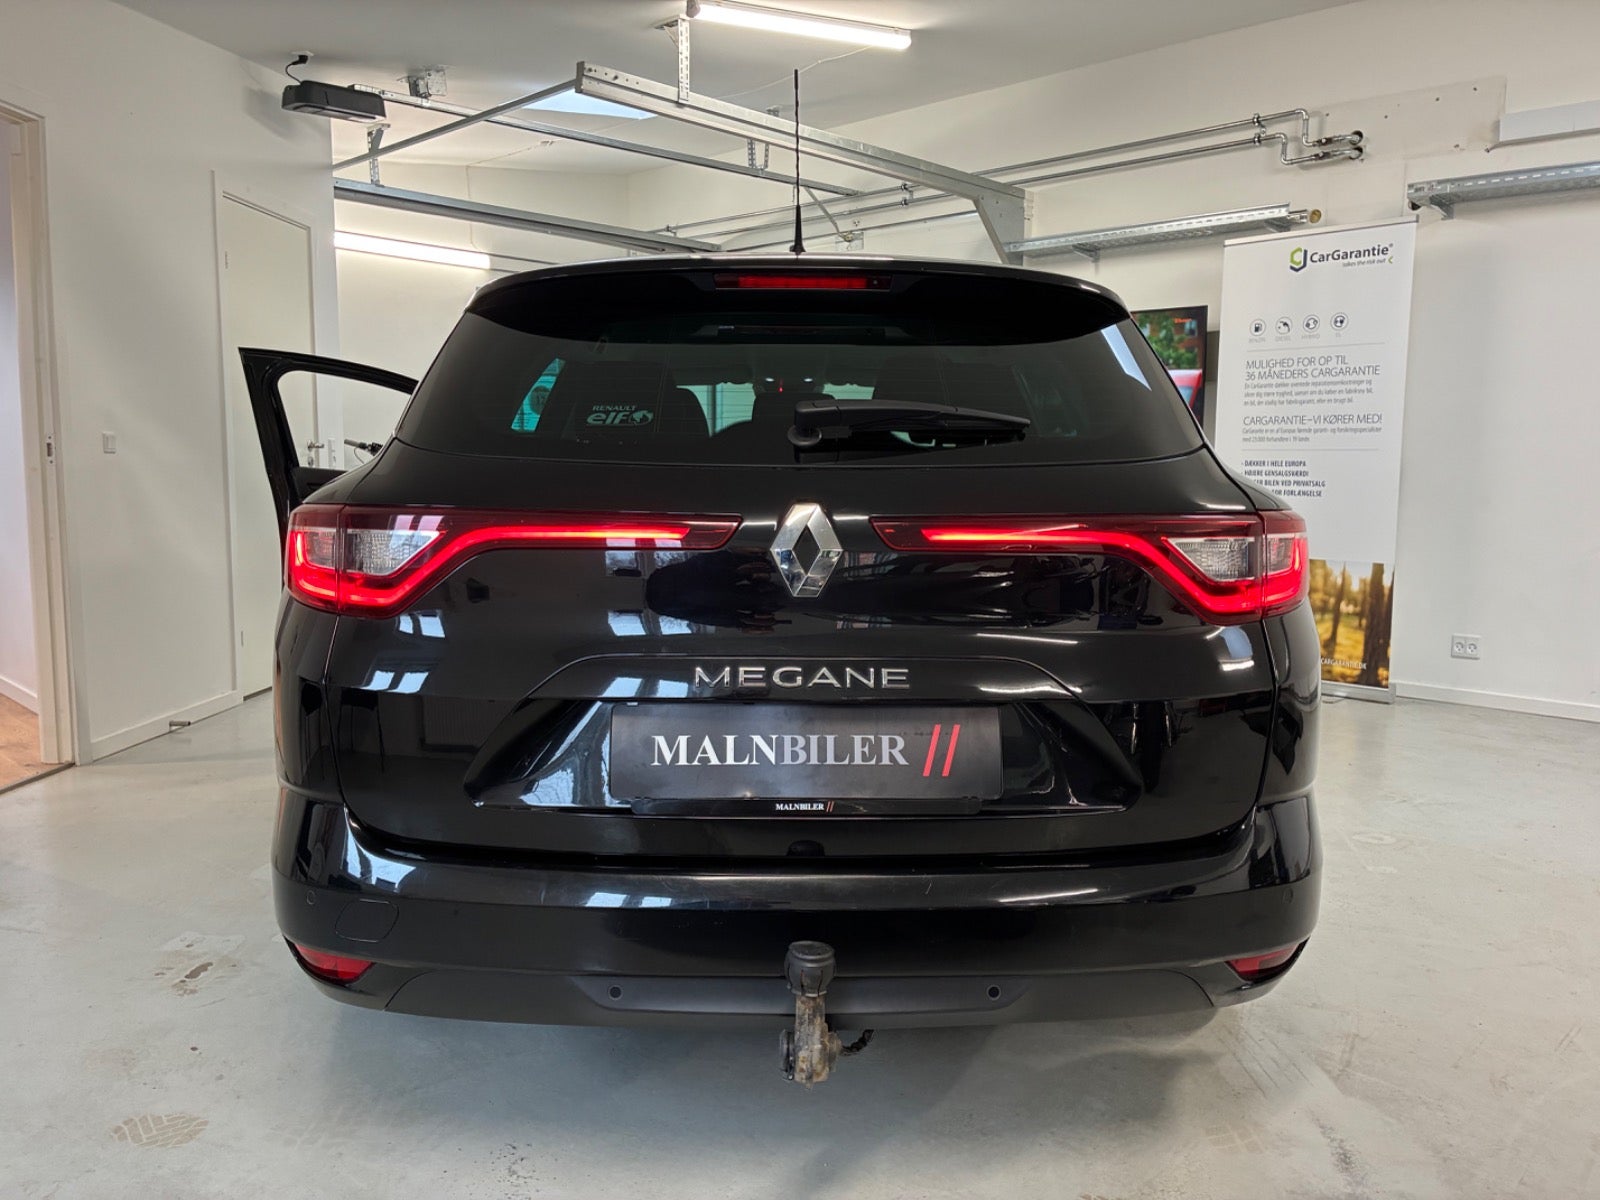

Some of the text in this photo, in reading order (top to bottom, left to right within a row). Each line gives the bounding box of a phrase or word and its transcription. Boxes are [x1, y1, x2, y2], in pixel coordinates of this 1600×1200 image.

[1246, 354, 1349, 370] MULIGHED FOR OP TIL
[1245, 364, 1380, 381] 36 MÅNEDERS CARGARANTIE
[586, 412, 630, 425] elf
[1322, 414, 1354, 424] KØRER
[1356, 412, 1382, 424] MED!
[694, 666, 910, 688] MEGANE
[650, 734, 910, 766] MALNBILER
[775, 802, 825, 811] MALNBILER
